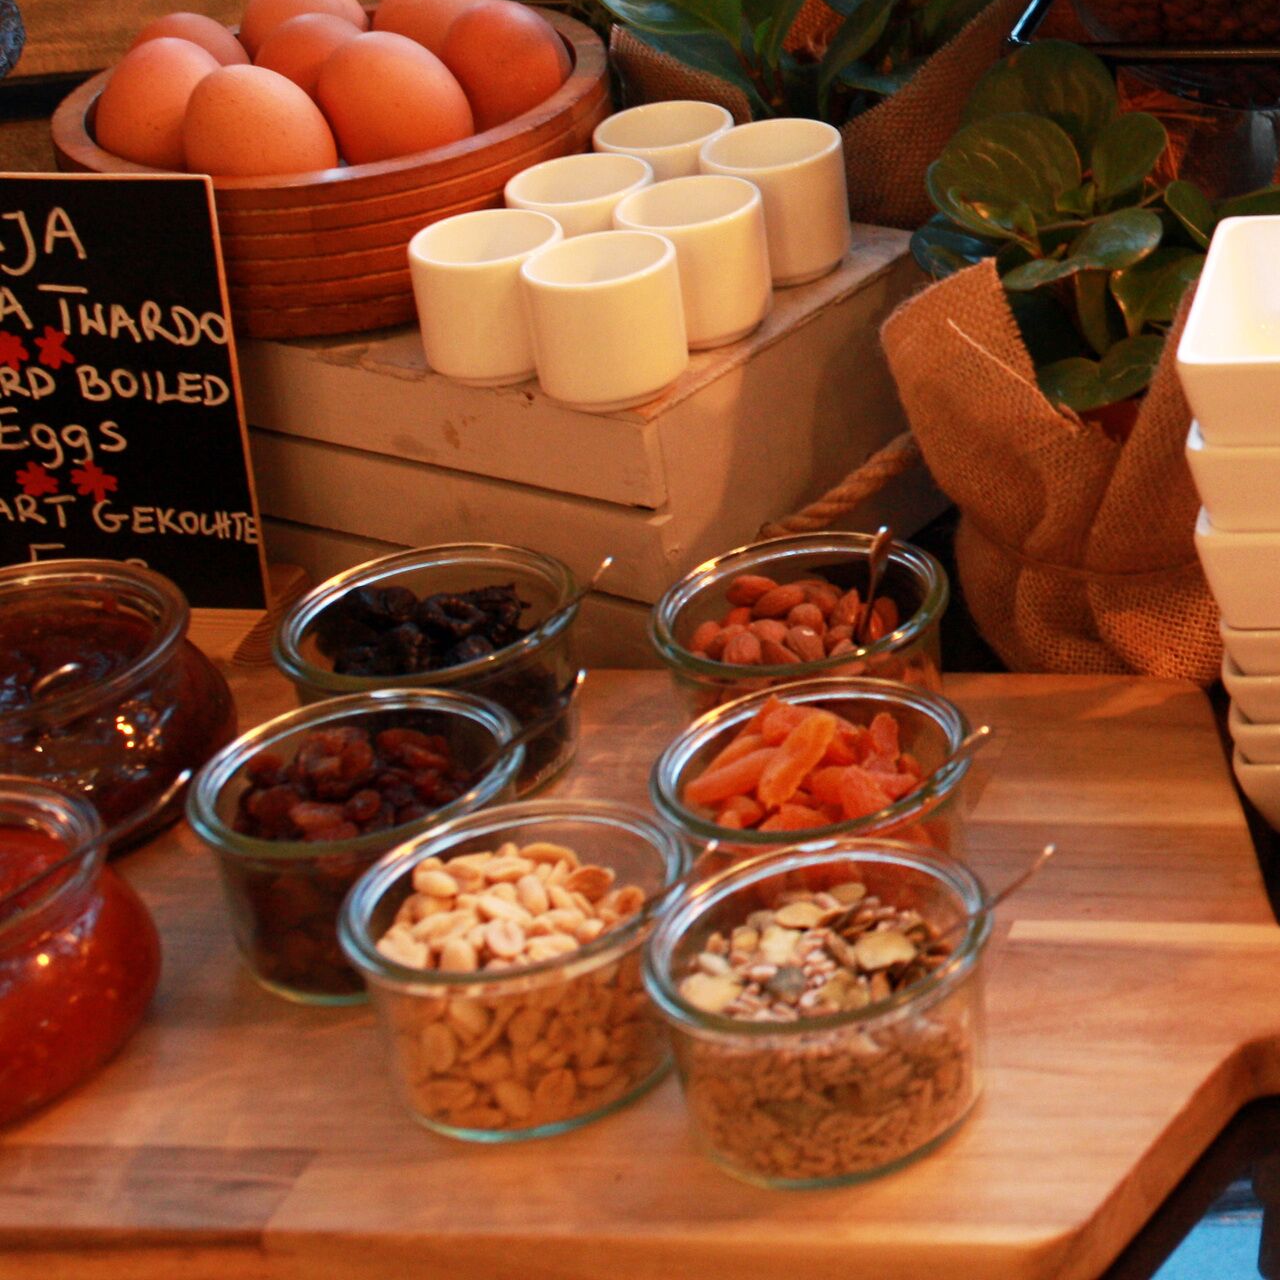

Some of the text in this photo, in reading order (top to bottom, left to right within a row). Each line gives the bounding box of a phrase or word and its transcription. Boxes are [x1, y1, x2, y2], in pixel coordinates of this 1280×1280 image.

[0, 206, 87, 277] JA
[0, 364, 230, 408] RD BOILED
[0, 406, 128, 470] Eggs
[92, 499, 260, 545] GEKOCHTE
